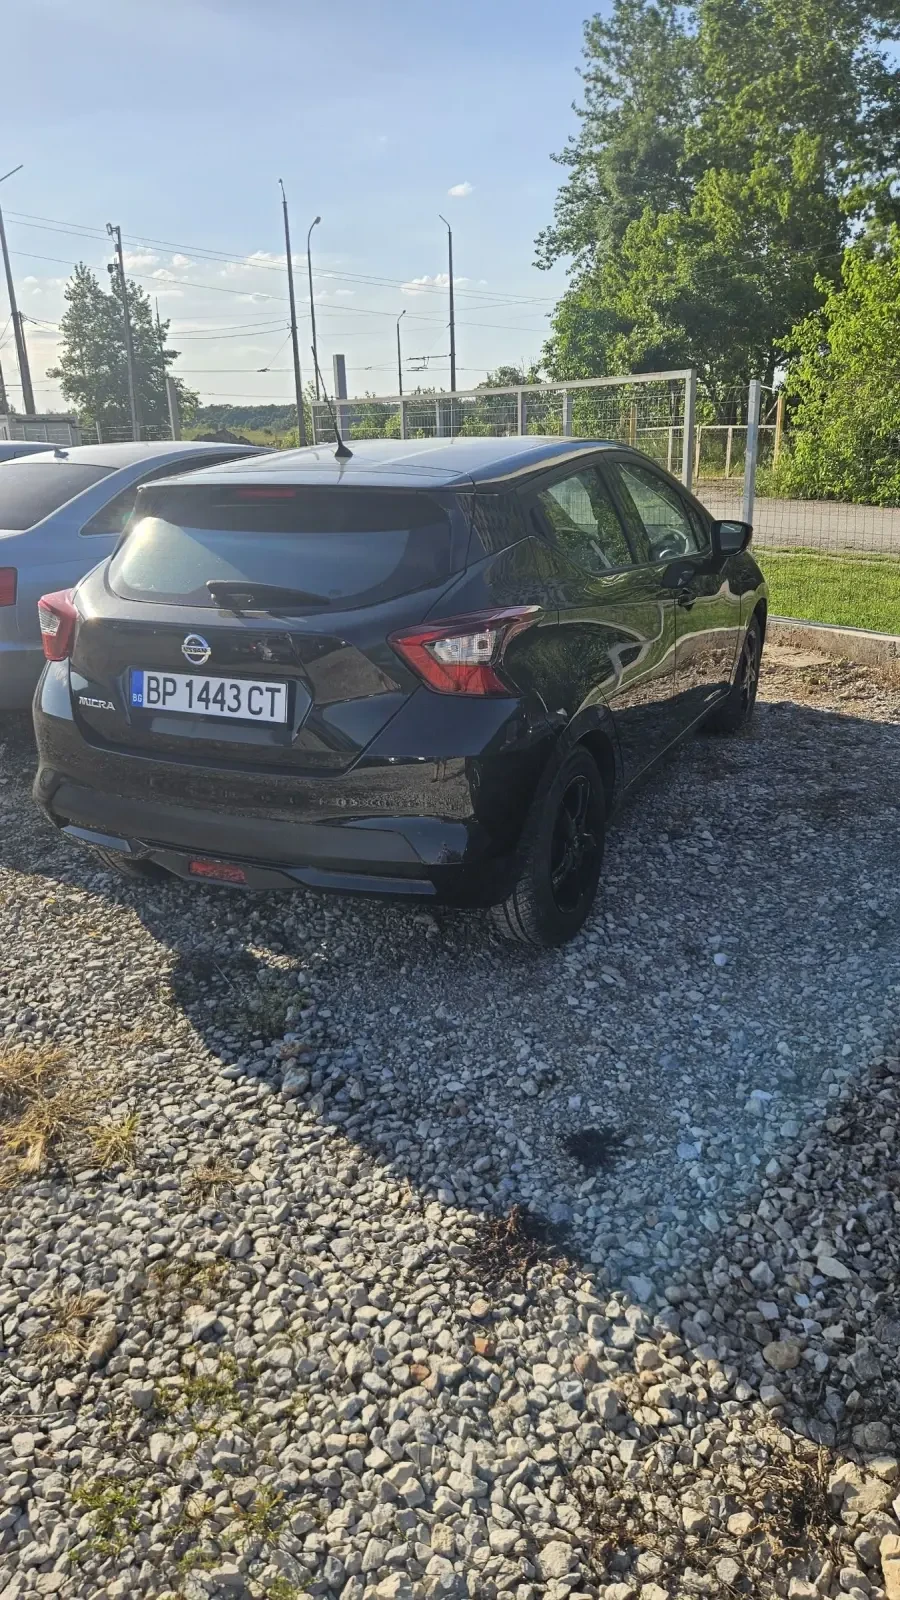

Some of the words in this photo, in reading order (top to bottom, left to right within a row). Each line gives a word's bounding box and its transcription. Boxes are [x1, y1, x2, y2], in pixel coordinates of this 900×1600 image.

[183, 646, 208, 654] NISSAN
[132, 693, 142, 702] BG
[147, 676, 177, 704] BP
[185, 679, 241, 712] 1443
[248, 686, 281, 717] CT
[79, 696, 116, 711] MICRA
